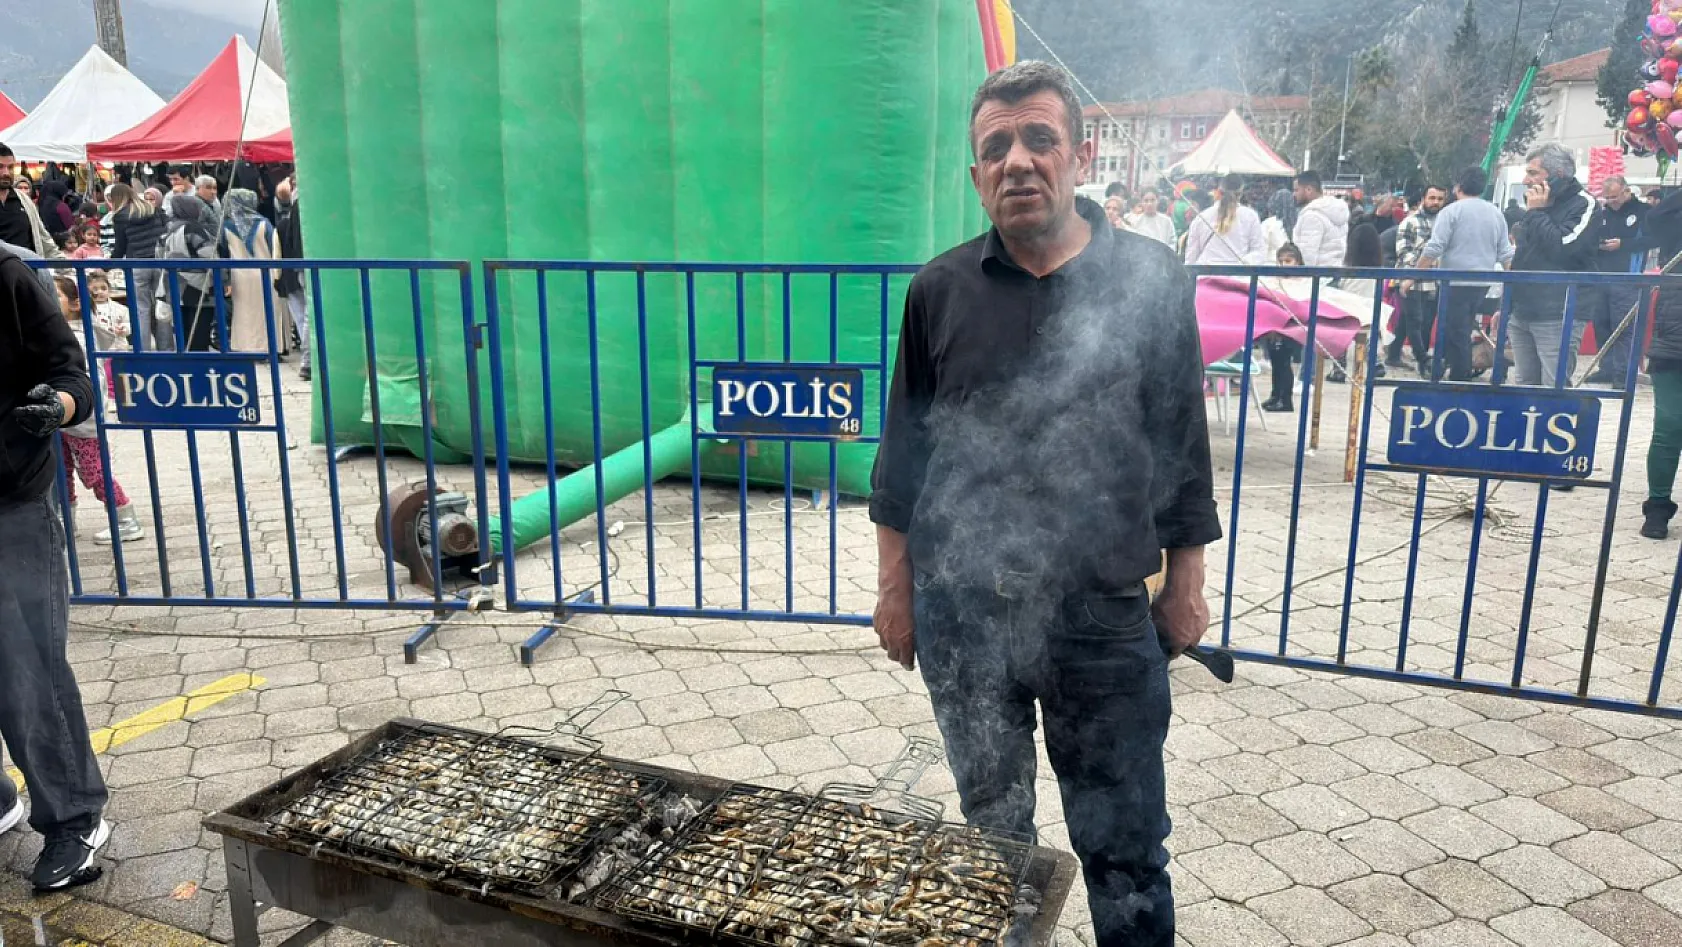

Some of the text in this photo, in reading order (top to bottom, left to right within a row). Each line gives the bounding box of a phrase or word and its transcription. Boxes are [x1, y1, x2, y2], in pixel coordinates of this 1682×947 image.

[118, 368, 249, 407] POLİS
[717, 377, 852, 418] POLİS
[238, 407, 257, 422] 48
[840, 418, 859, 432] 48
[1396, 405, 1578, 455] POLİS
[1561, 455, 1588, 472] 48
